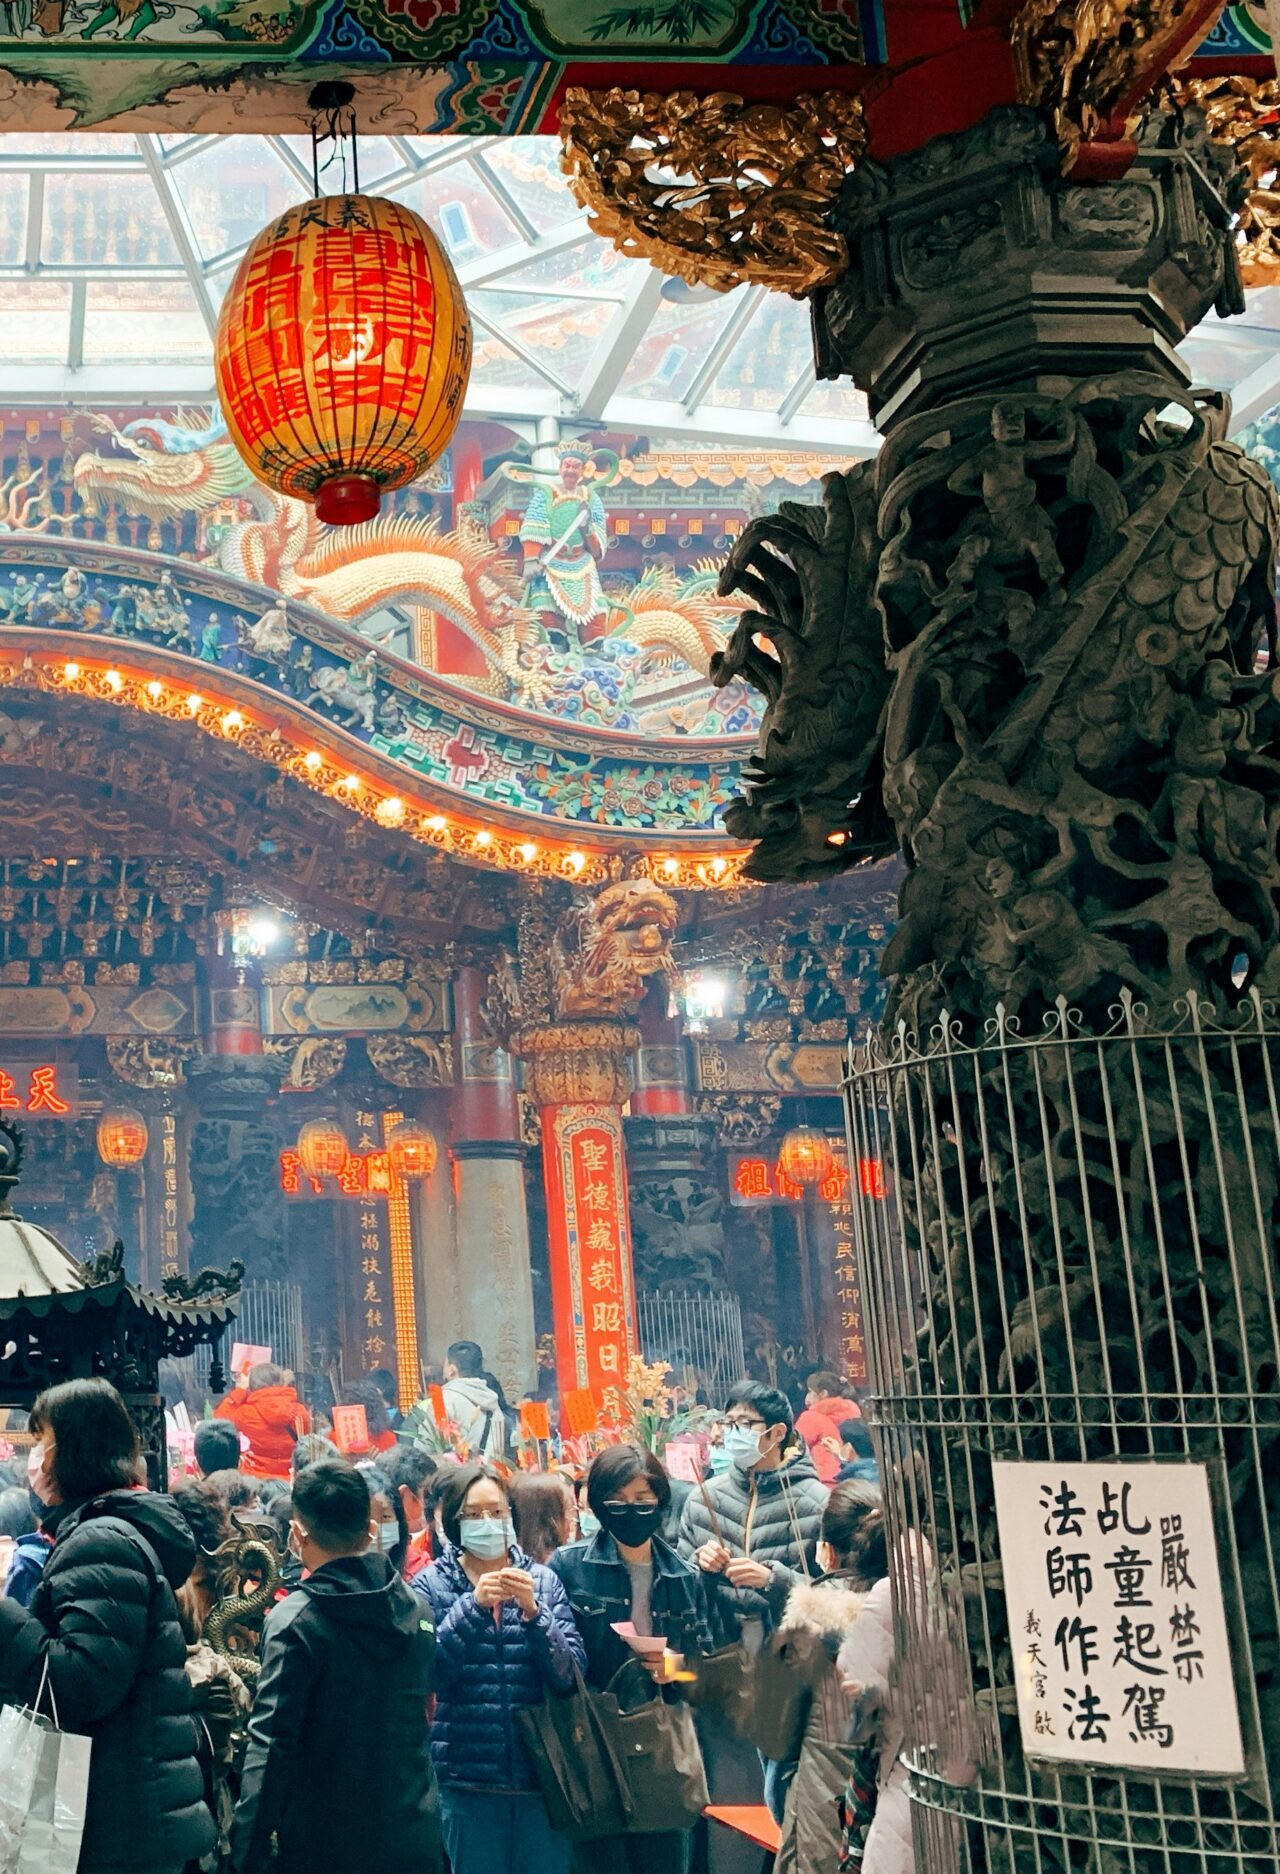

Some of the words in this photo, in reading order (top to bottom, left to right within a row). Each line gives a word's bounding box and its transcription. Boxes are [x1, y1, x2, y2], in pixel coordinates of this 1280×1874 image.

[1039, 1480, 1113, 1745] 法師作法
[1096, 1481, 1175, 1749] 乩童起駕
[1160, 1513, 1205, 1685] 嚴禁
